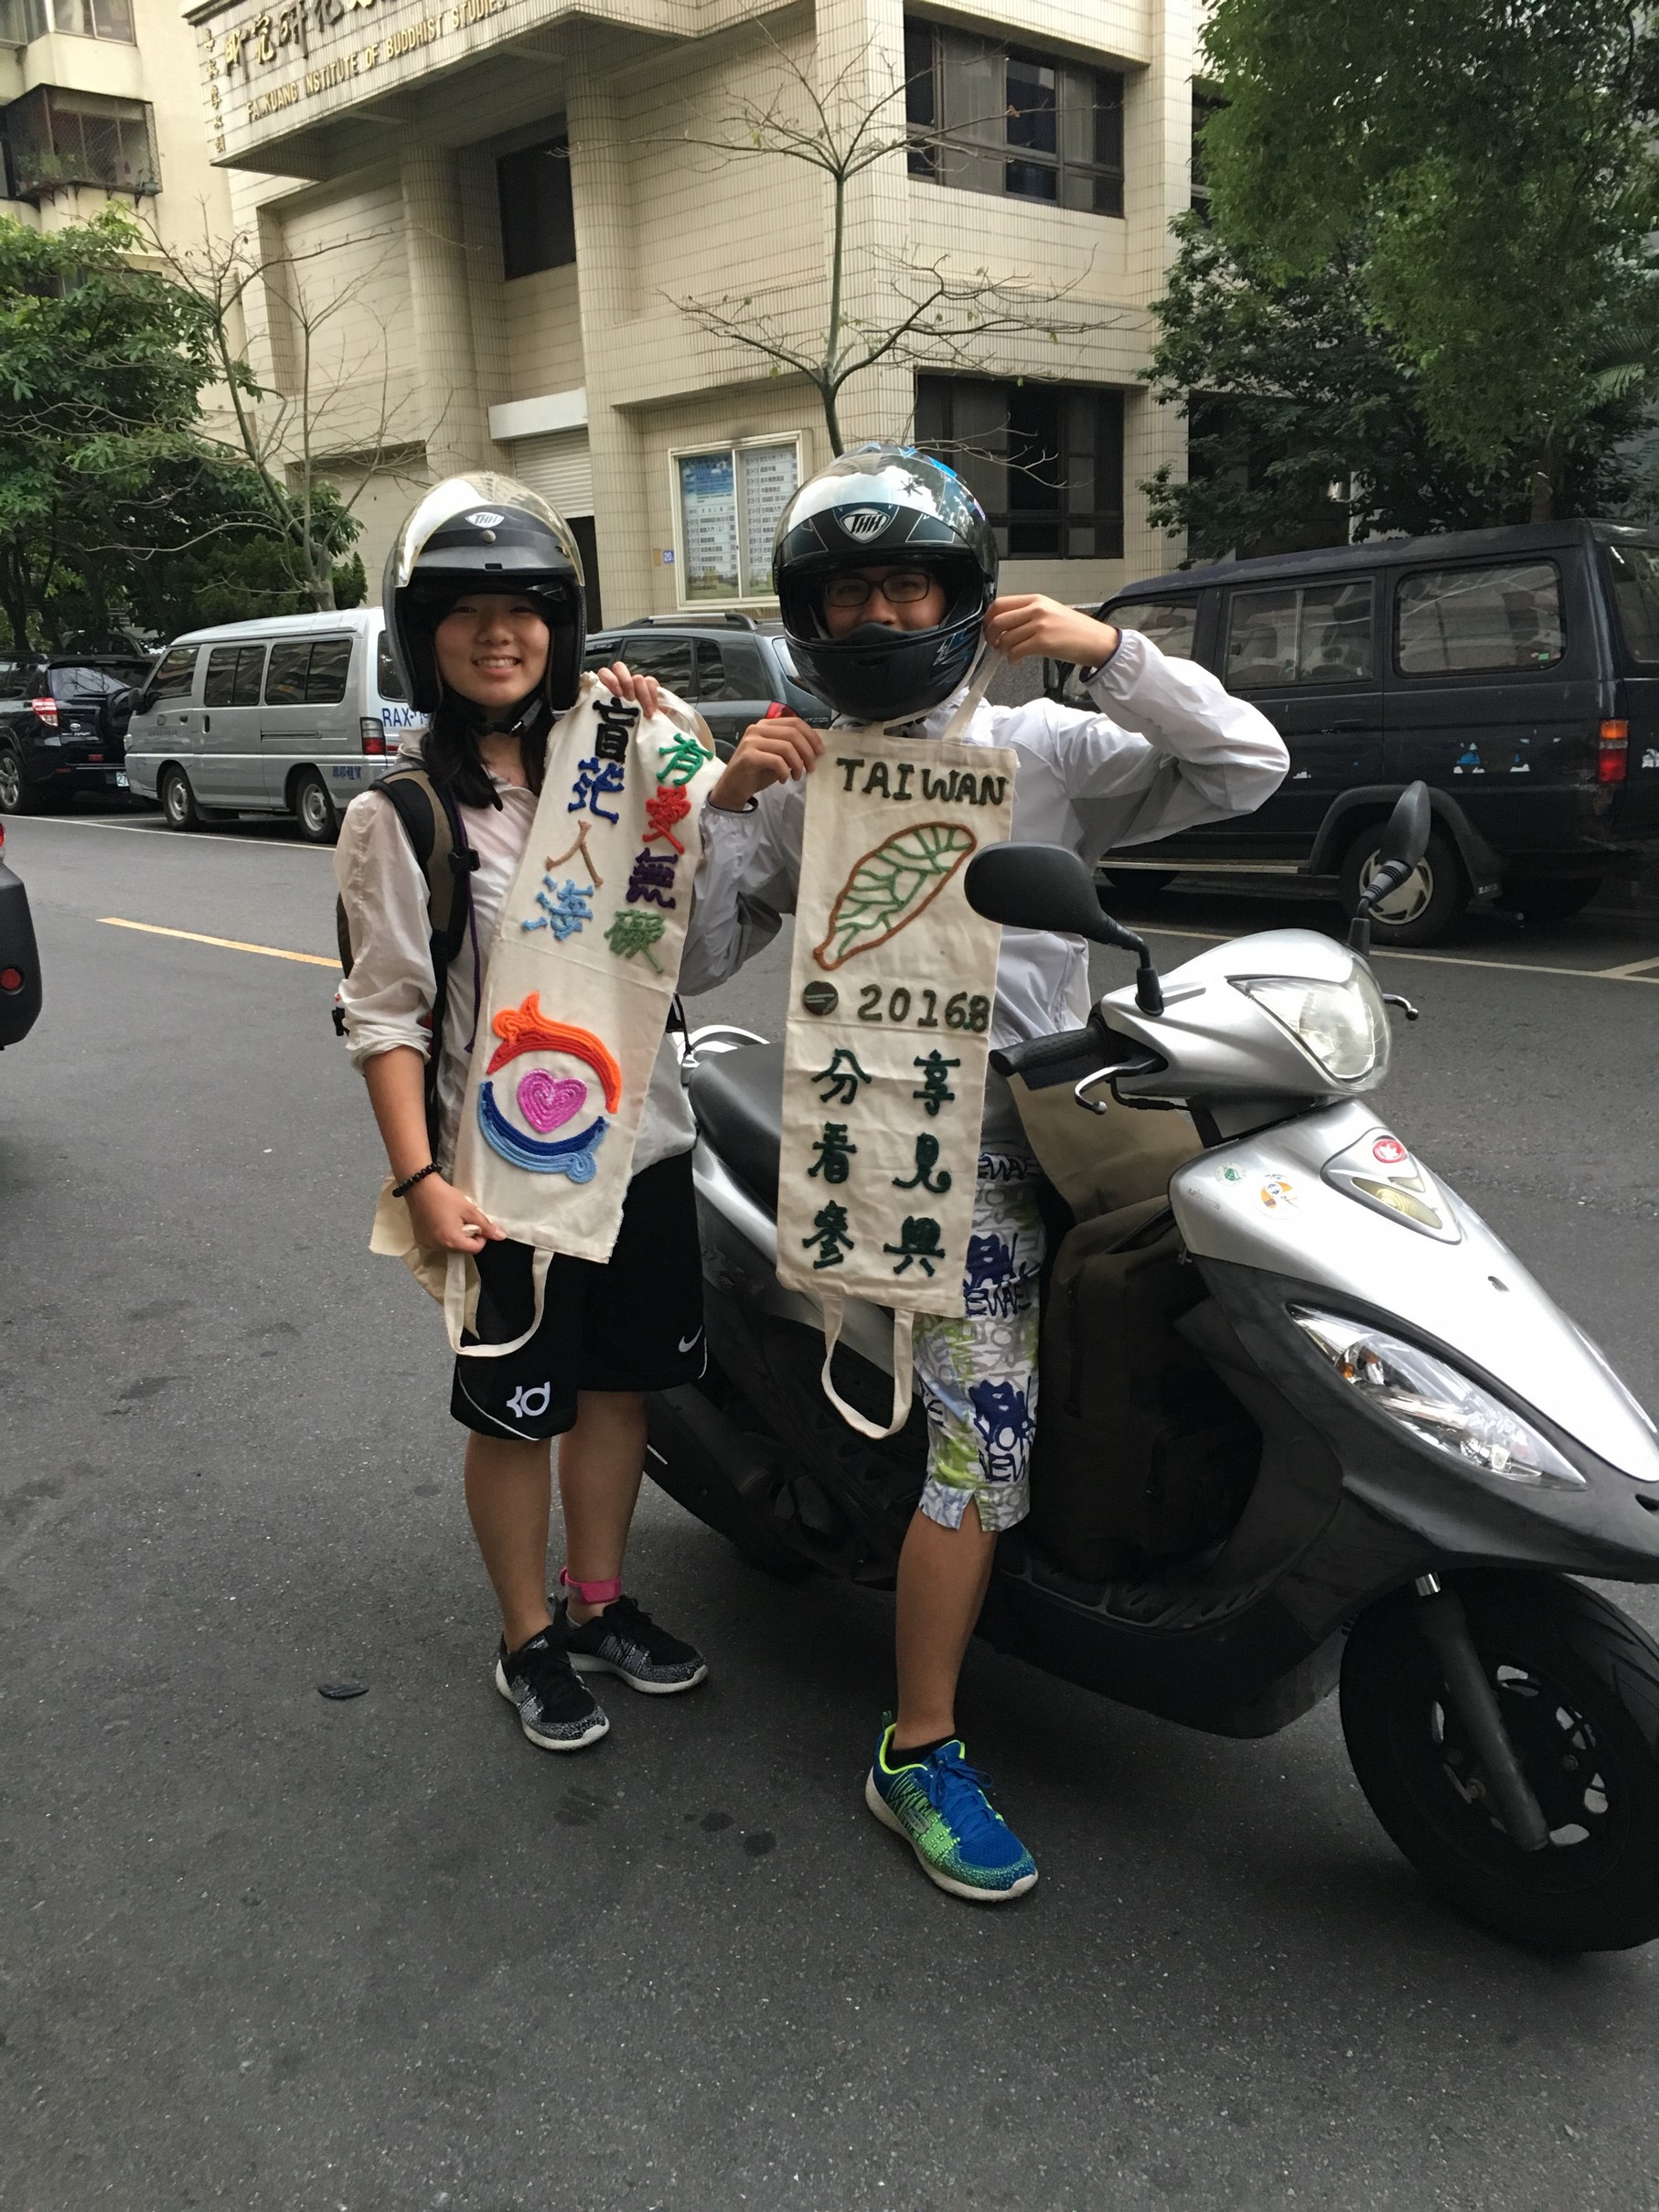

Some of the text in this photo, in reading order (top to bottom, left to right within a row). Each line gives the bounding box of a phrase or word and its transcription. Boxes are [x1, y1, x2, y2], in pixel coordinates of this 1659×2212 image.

[366, 46, 380, 68] OF
[386, 15, 443, 59] BUDDHIST
[850, 513, 883, 534] THH
[836, 757, 1009, 806] TAIWAN
